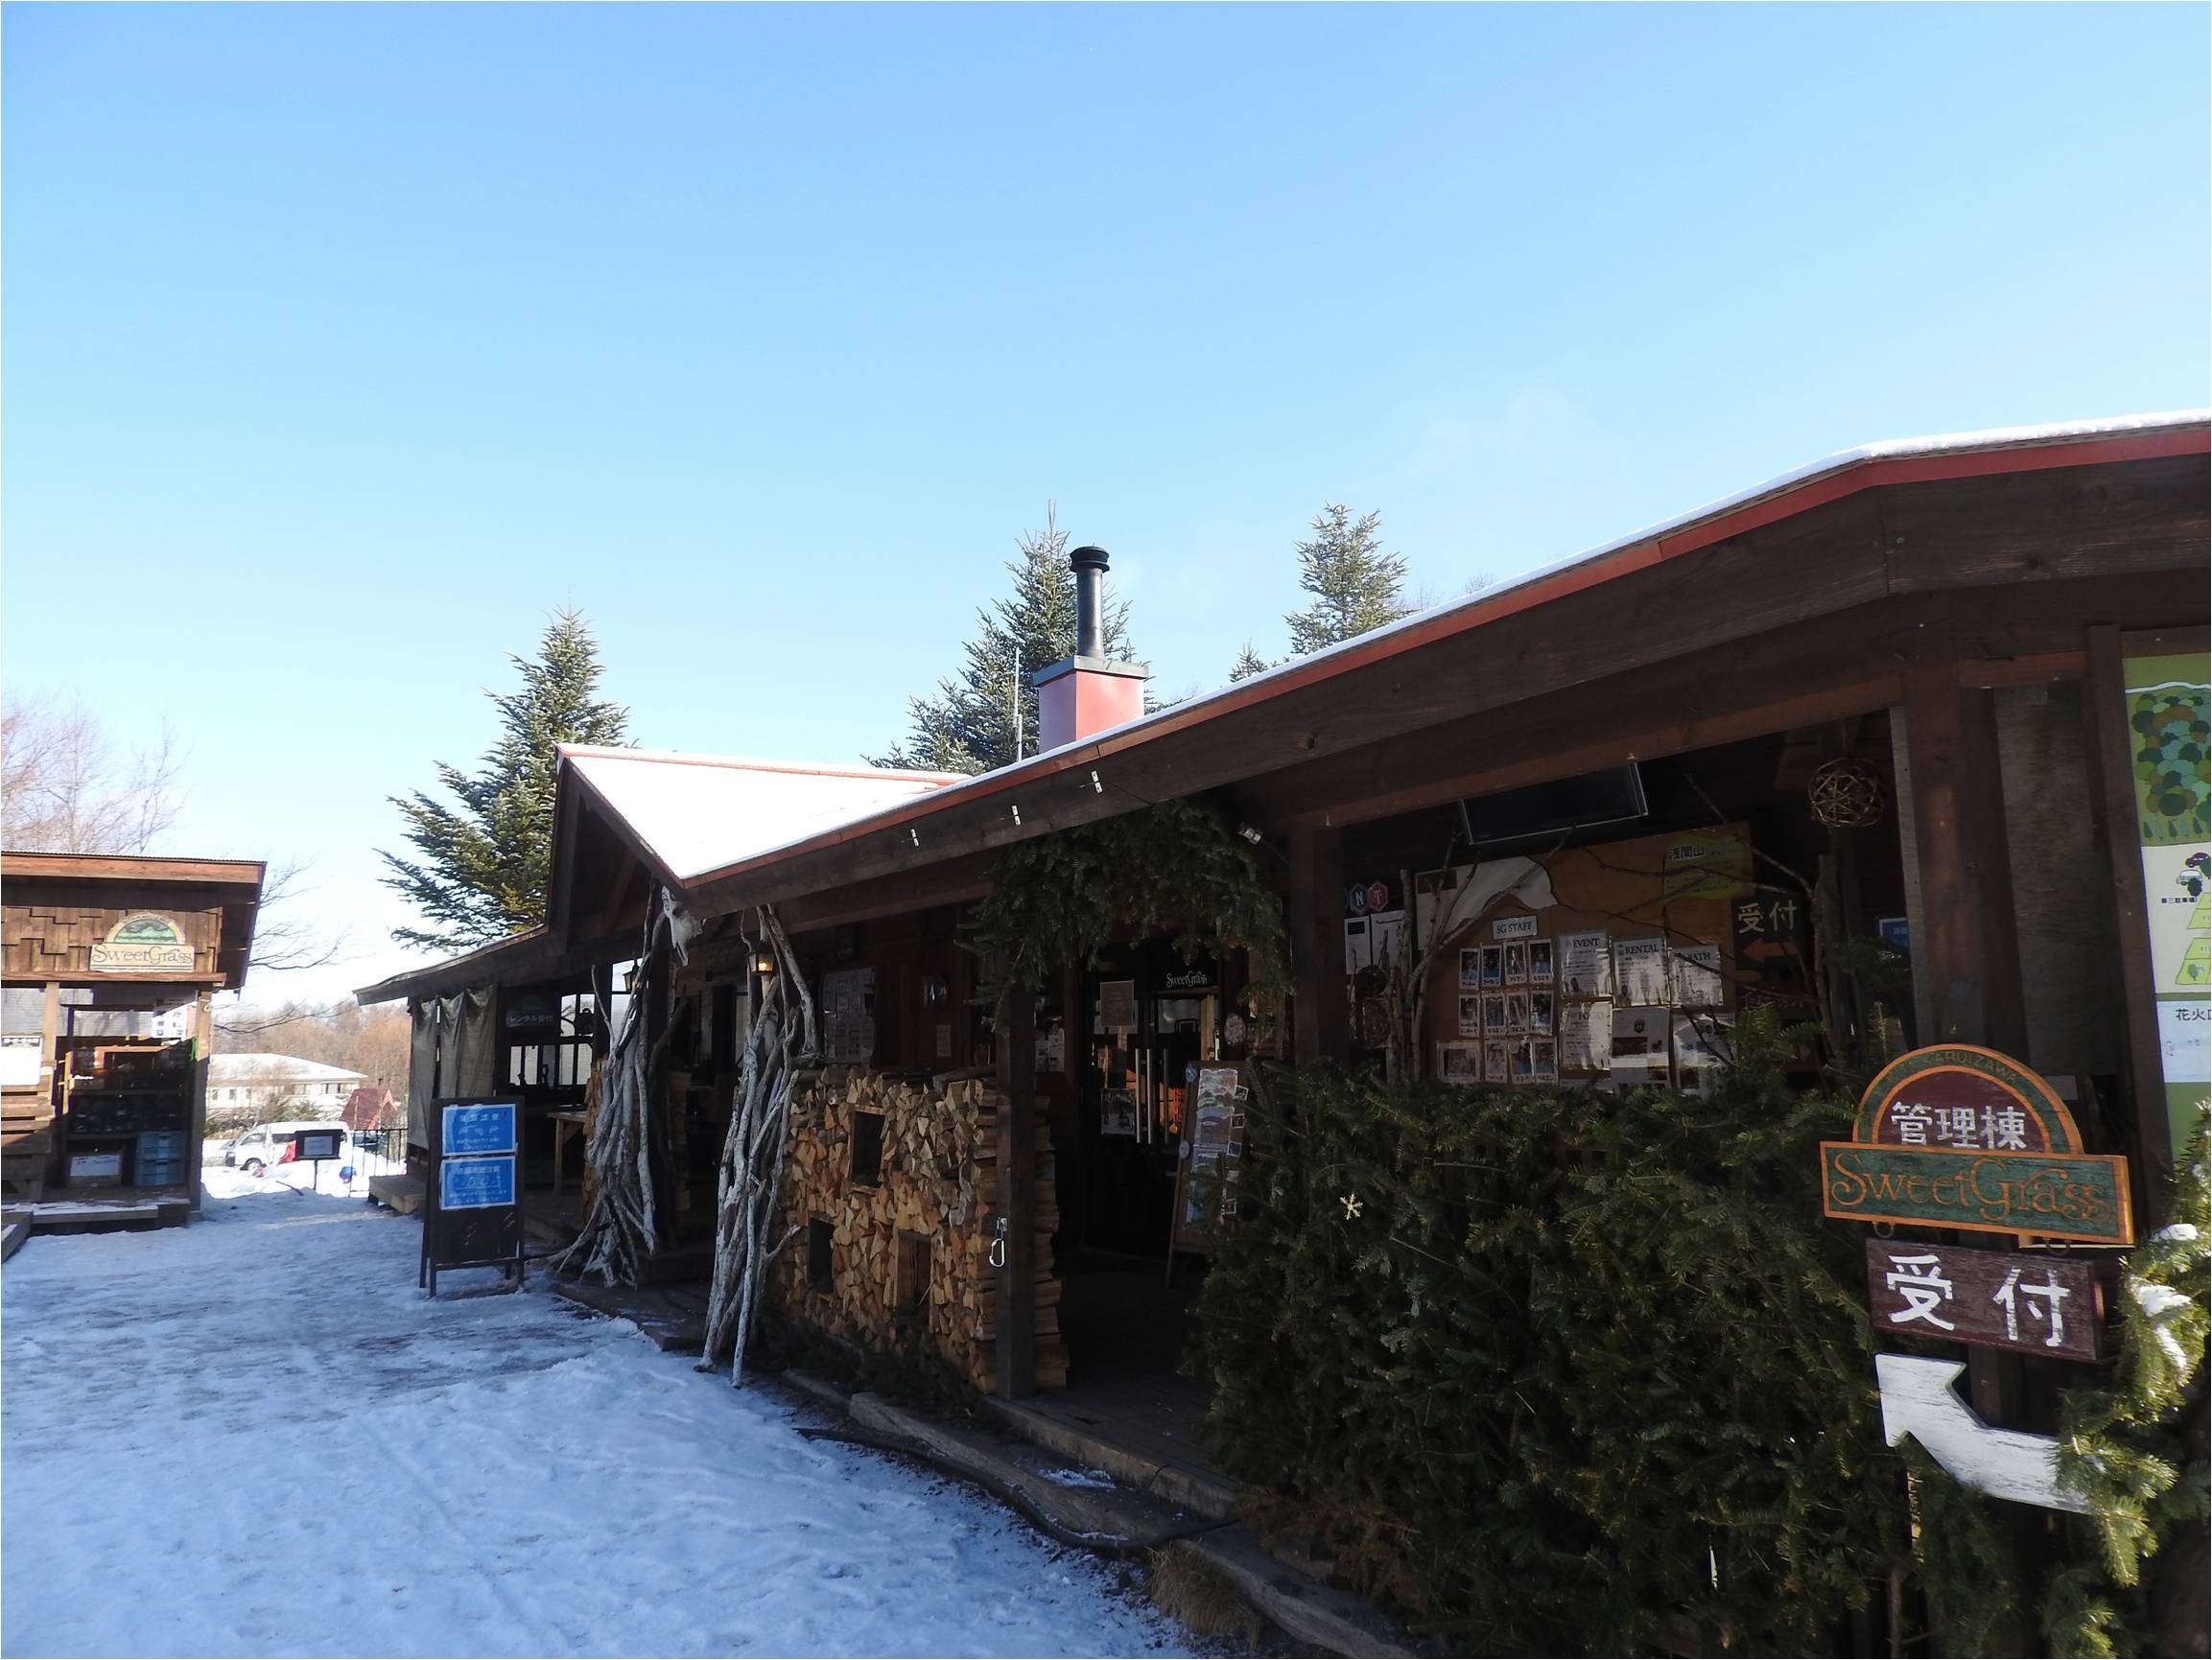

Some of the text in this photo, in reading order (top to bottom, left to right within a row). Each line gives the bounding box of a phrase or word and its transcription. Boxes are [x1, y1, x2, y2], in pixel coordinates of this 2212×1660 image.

[1508, 921, 1533, 933] STAFF
[1737, 899, 1798, 935] 受付
[1573, 938, 1600, 948] EVENT
[1625, 944, 1659, 954] RENTAL
[1890, 1100, 2028, 1151] 管理棟
[1885, 1252, 2072, 1348] 受付
